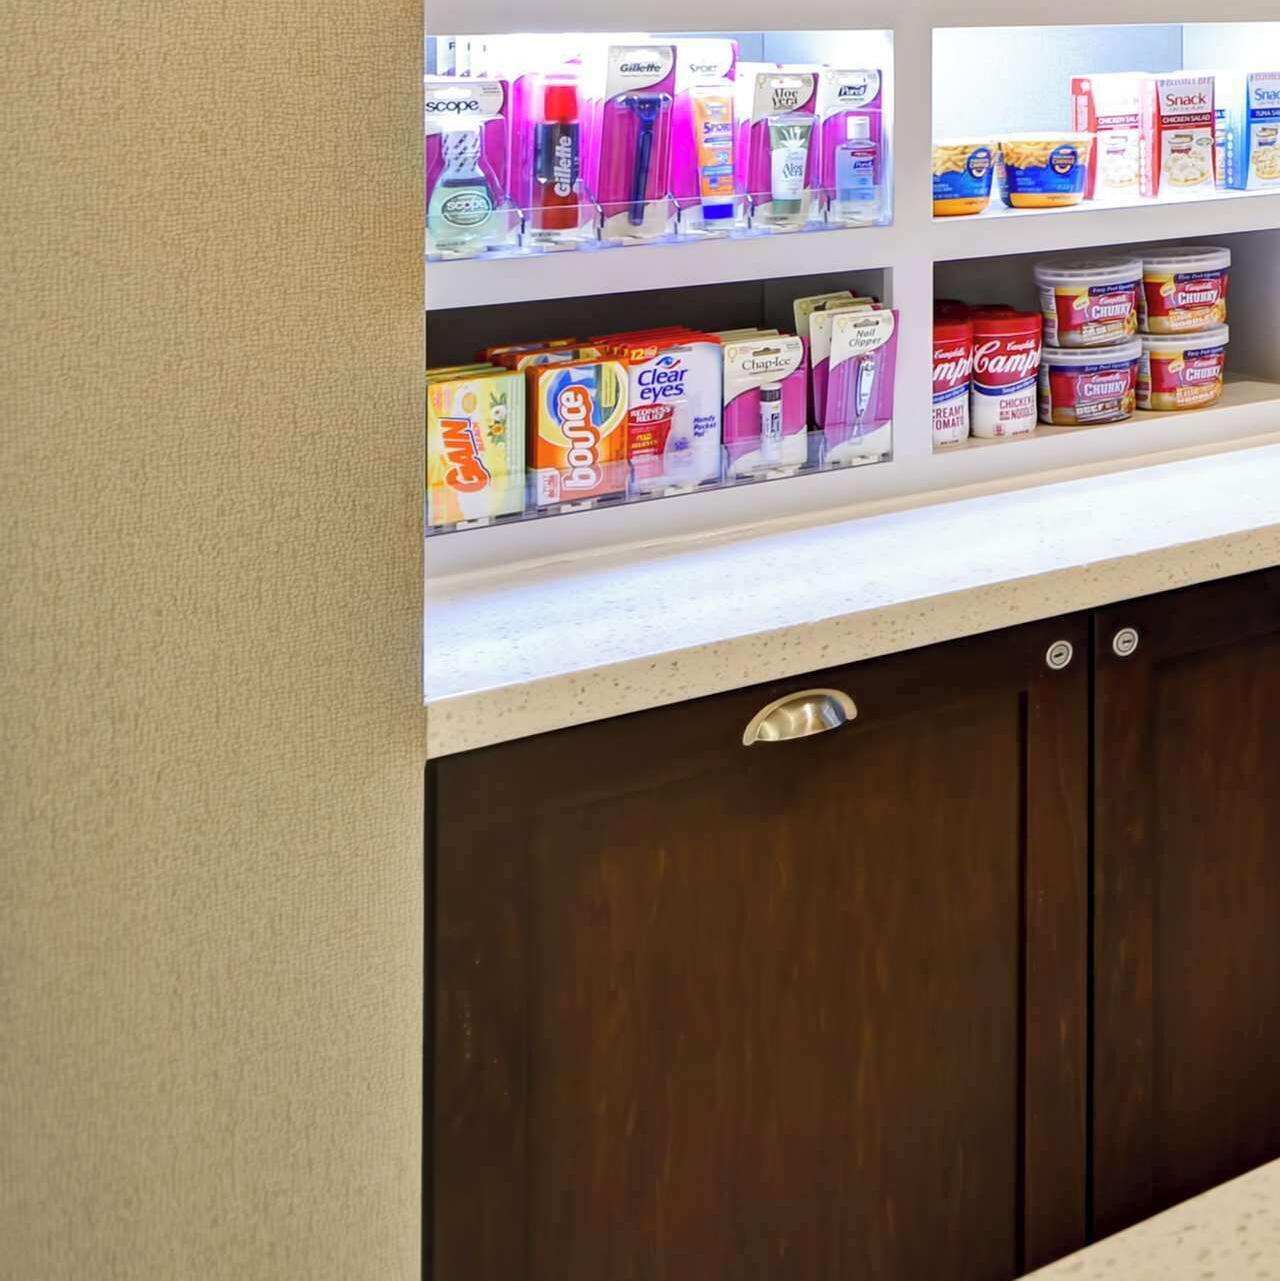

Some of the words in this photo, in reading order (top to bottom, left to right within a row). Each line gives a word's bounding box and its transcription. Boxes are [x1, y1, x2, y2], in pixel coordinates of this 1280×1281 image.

[620, 63, 662, 73] Gillette
[773, 88, 799, 98] Aloe
[1166, 92, 1207, 106] Snack
[426, 99, 479, 115] scope
[772, 96, 799, 106] Vera
[1162, 116, 1189, 124] CHICKEN
[1190, 114, 1210, 122] SALAD
[555, 135, 572, 197] Gillette
[1178, 290, 1218, 305] CHUNKY
[1092, 302, 1132, 319] CHUNKY
[857, 328, 876, 338] Nail
[848, 337, 882, 348] Clipper
[637, 368, 688, 387] Clear
[1185, 366, 1221, 381] CHUNKY
[640, 383, 685, 404] eyes
[1084, 381, 1127, 396] CHUNKY
[630, 405, 673, 418] REDNESS
[636, 412, 665, 423] RELIEF
[564, 390, 597, 490] bounce
[440, 419, 489, 493] GAIN
